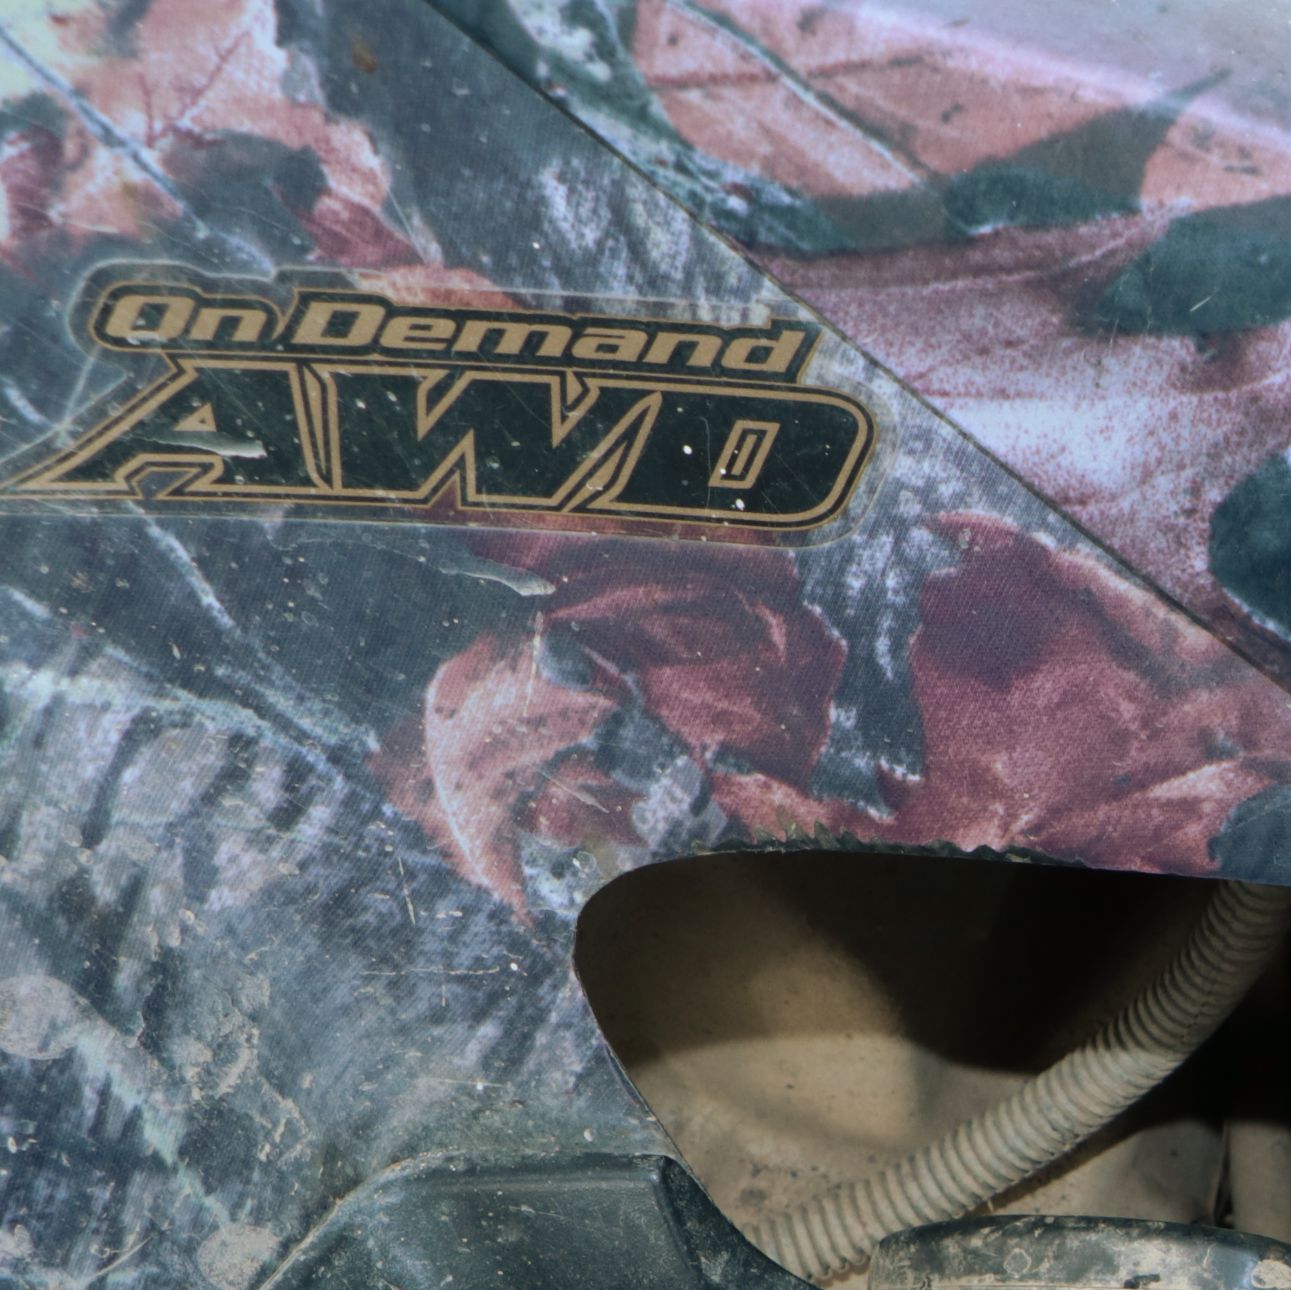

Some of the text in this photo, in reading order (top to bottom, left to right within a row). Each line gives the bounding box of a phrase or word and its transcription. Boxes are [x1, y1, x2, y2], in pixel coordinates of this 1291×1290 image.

[103, 294, 806, 376] On Demand
[0, 355, 878, 530] AWD
